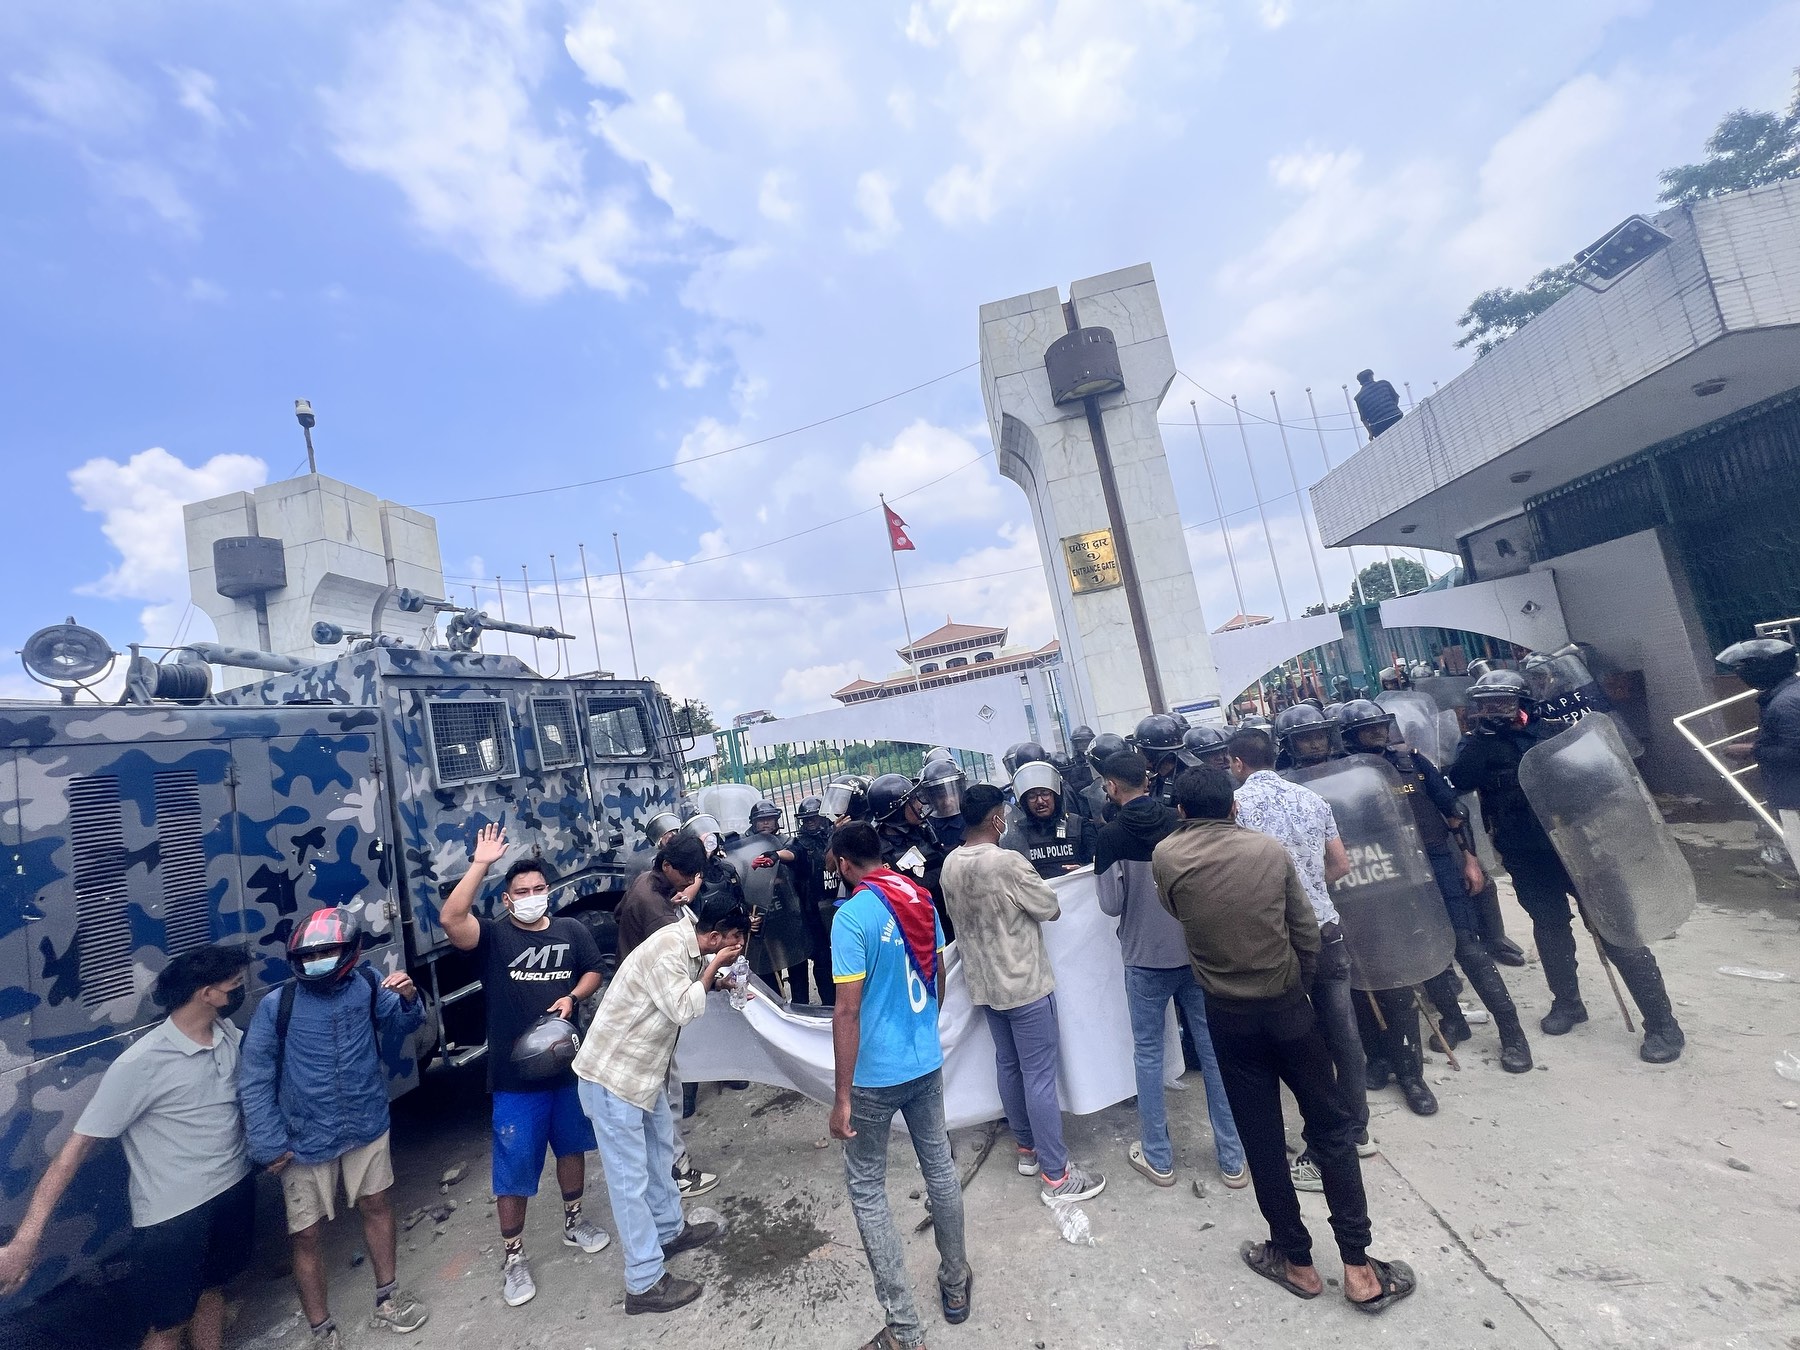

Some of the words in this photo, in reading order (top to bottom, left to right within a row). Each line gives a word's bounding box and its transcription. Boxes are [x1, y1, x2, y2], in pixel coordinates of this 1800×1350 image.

[1069, 542, 1089, 554] प्रवेश
[1092, 538, 1109, 549] द्वार
[1072, 564, 1101, 577] ENTRANCE
[1102, 561, 1116, 570] GATE
[1030, 847, 1046, 861] EPAL
[1046, 844, 1074, 858] POLICE
[1345, 843, 1393, 867] EPAL
[508, 943, 570, 969] MT
